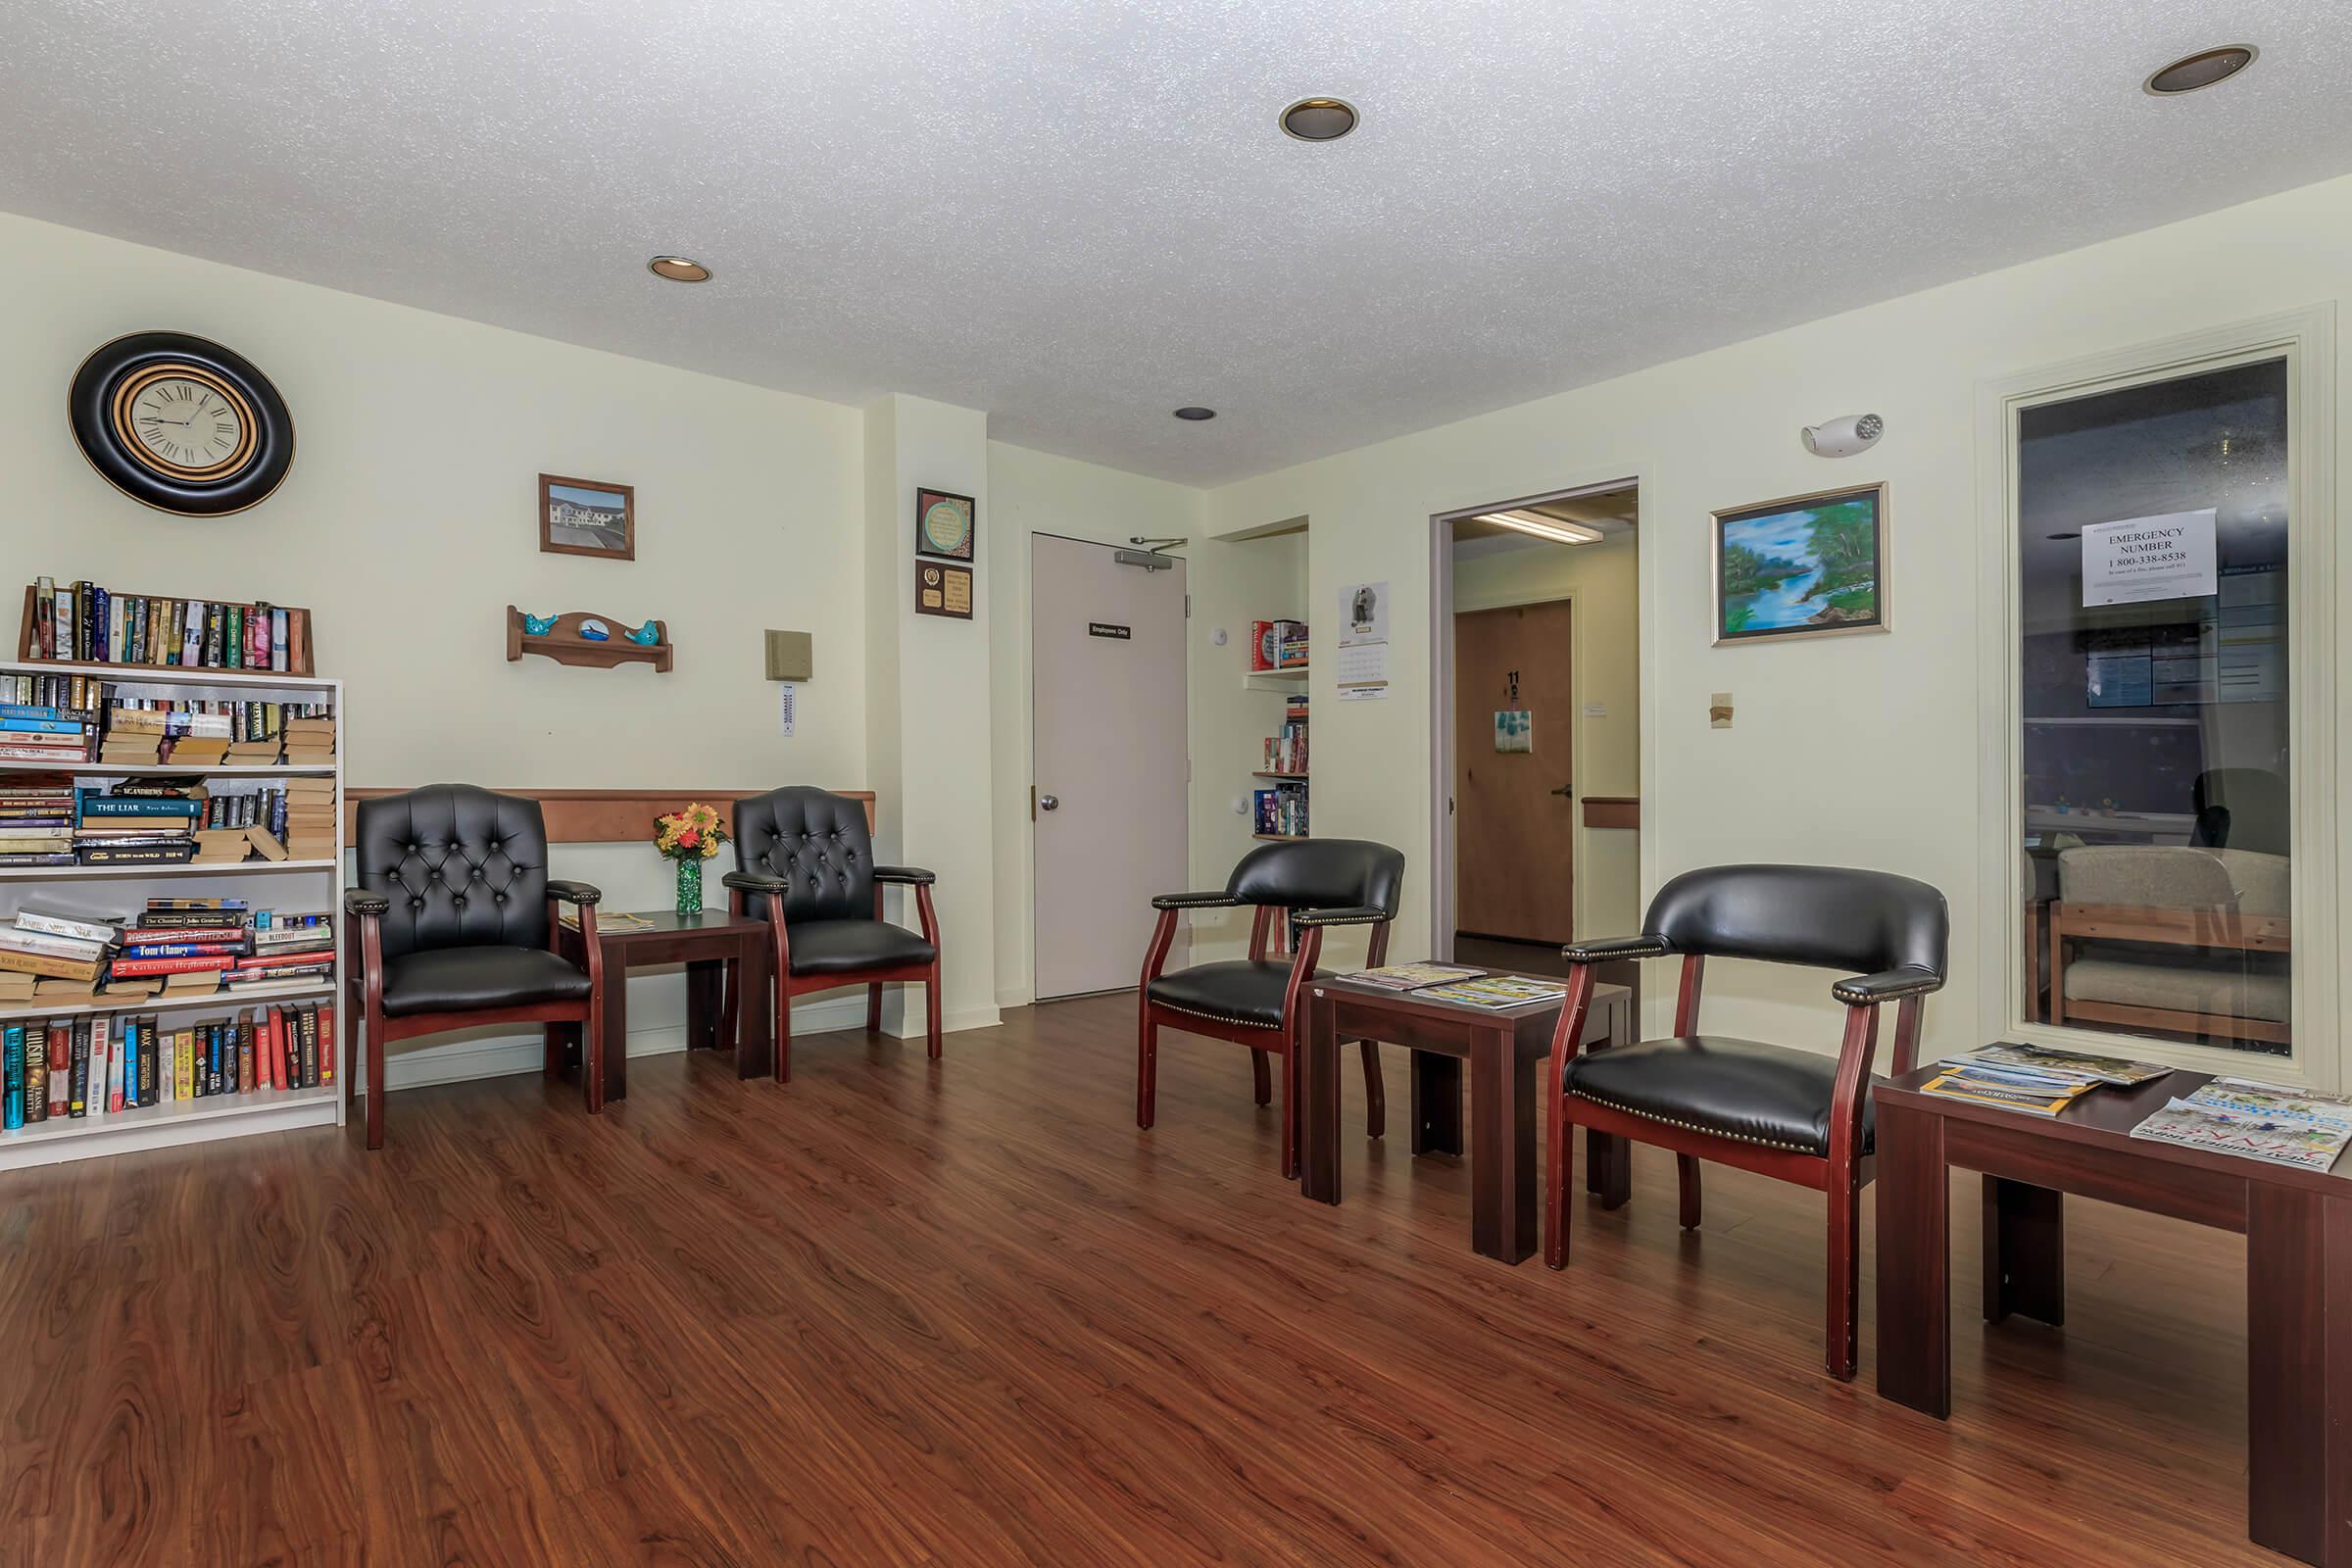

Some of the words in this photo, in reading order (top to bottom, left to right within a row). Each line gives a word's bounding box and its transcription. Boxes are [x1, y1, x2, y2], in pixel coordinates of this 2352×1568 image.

[2109, 526, 2184, 545] EMERGENCY
[2120, 540, 2173, 554] NUMBER
[2108, 560, 2113, 568] 1
[2117, 551, 2187, 567] 800-338-8538
[1092, 626, 1117, 635] Employees
[1508, 670, 1519, 684] 11
[139, 946, 158, 956] Tom
[160, 945, 189, 956] Clancy
[142, 1029, 151, 1046] MAX
[26, 1031, 44, 1067] ILLUSION
[26, 1085, 35, 1113] PERETTI
[35, 1086, 44, 1111] FRANK
[2193, 1138, 2260, 1154] GUIDED
[2266, 1151, 2324, 1165] GREAT
